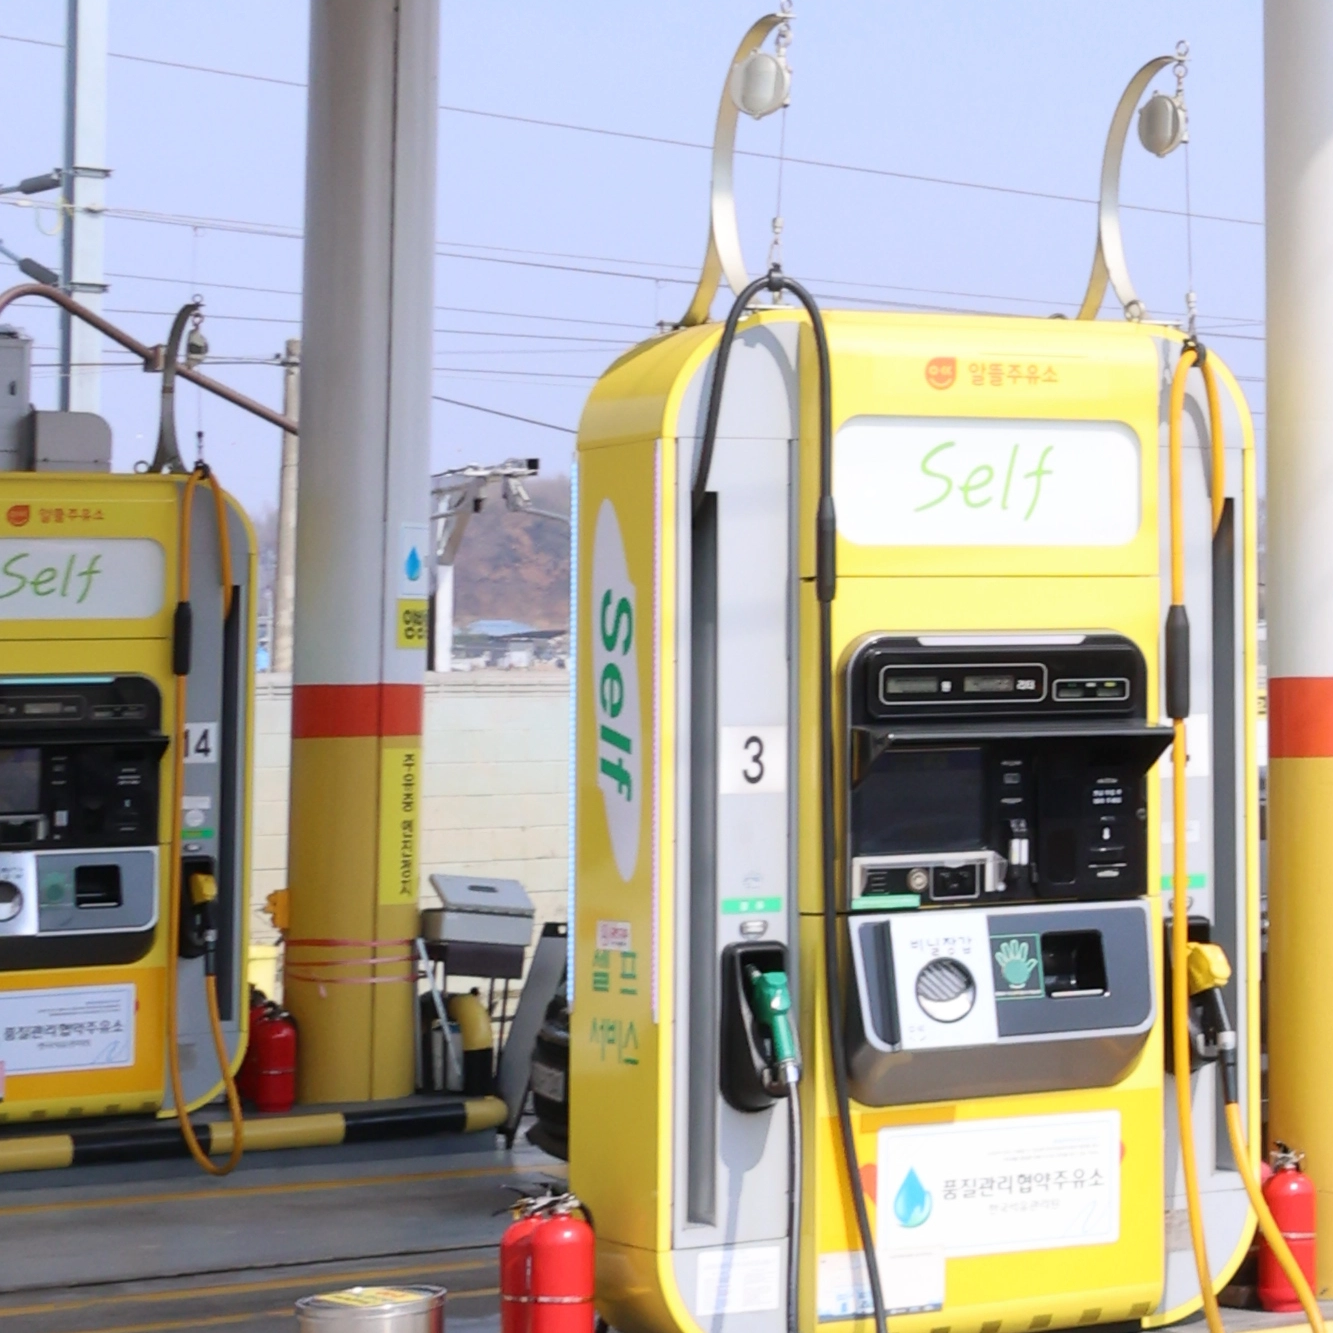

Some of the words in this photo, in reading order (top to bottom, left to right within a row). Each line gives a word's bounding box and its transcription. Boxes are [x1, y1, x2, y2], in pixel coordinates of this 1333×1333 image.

[967, 361, 1060, 387] 알뜰주유소
[913, 439, 1055, 522] Self
[0, 551, 102, 604] Self
[600, 588, 634, 802] Self
[182, 727, 212, 759] 14
[742, 735, 765, 785] 3
[910, 936, 973, 956] 비닐장갑
[942, 1167, 1106, 1202] 품질관리협약주유소
